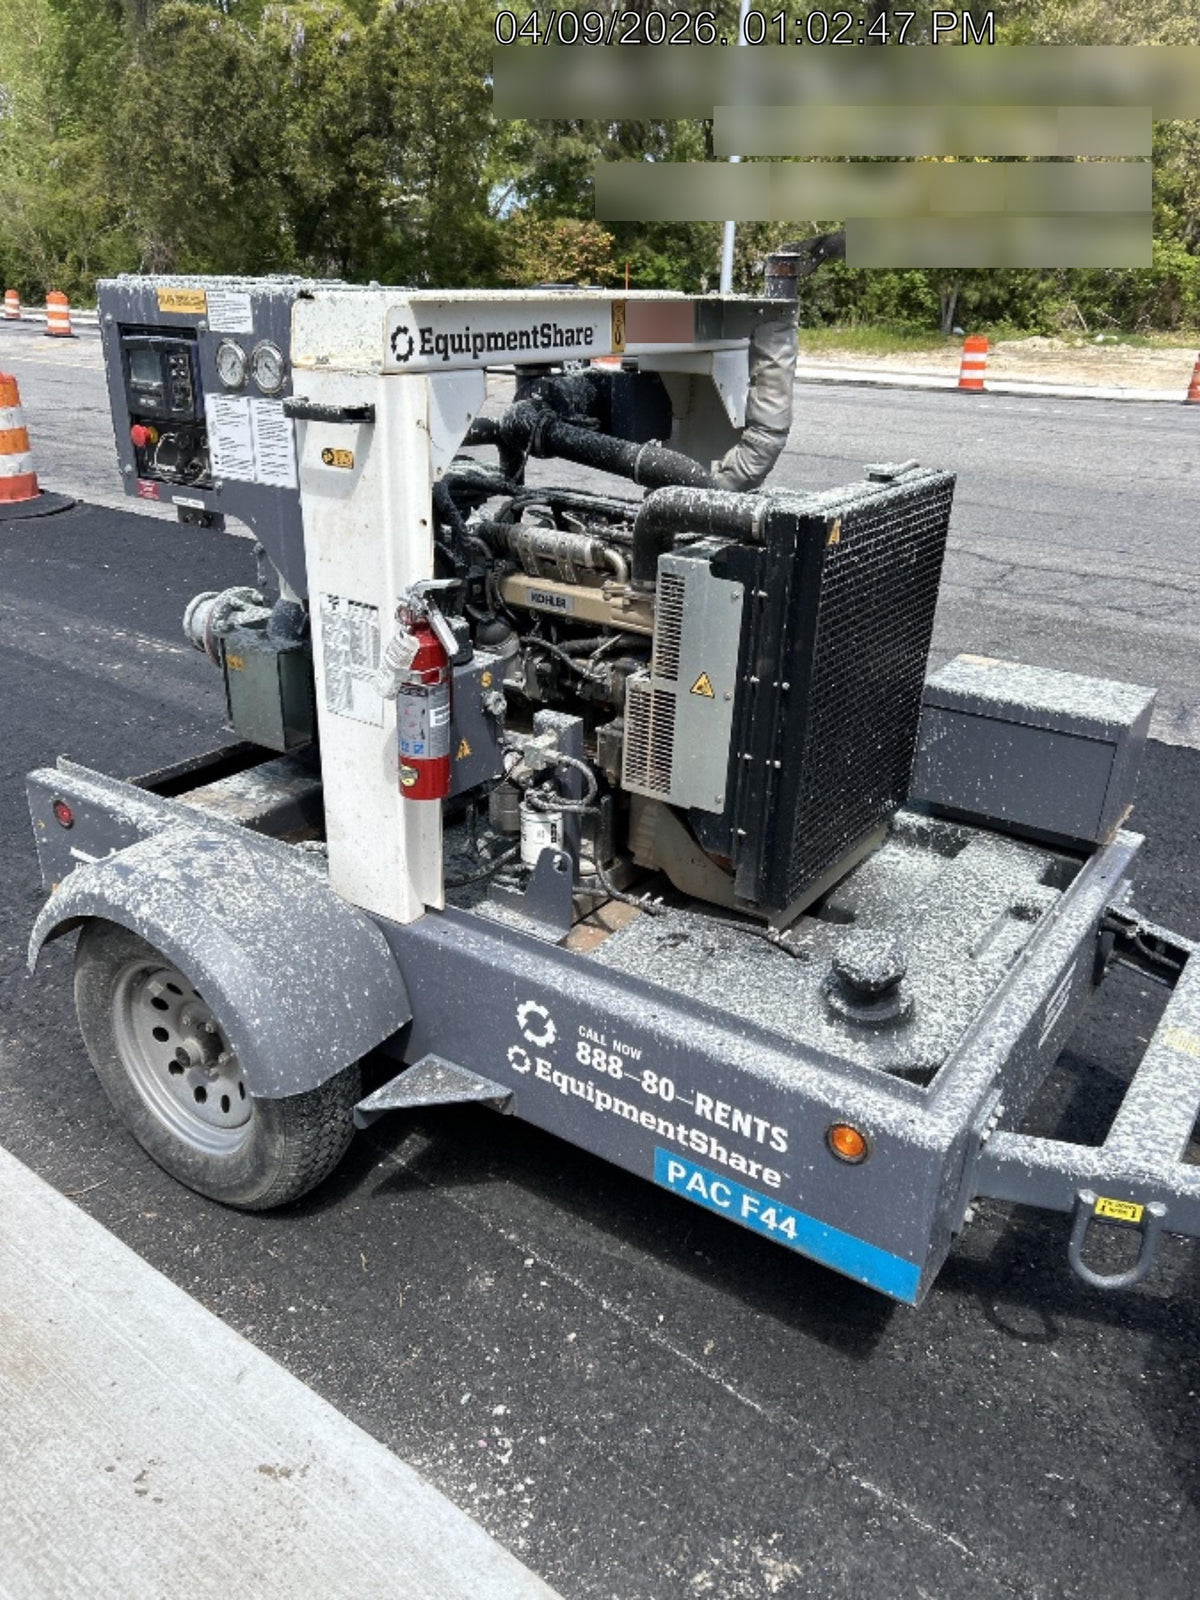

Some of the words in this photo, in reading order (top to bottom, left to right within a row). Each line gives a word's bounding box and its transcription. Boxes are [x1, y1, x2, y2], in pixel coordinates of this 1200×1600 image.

[419, 322, 594, 362] EquipmentShare
[531, 592, 567, 609] KOHLER
[578, 1025, 607, 1046] CALL
[612, 1040, 642, 1060] NOW
[535, 1057, 782, 1189] EquipmentShare
[668, 1160, 732, 1208] PAC
[741, 1194, 798, 1240] F44
